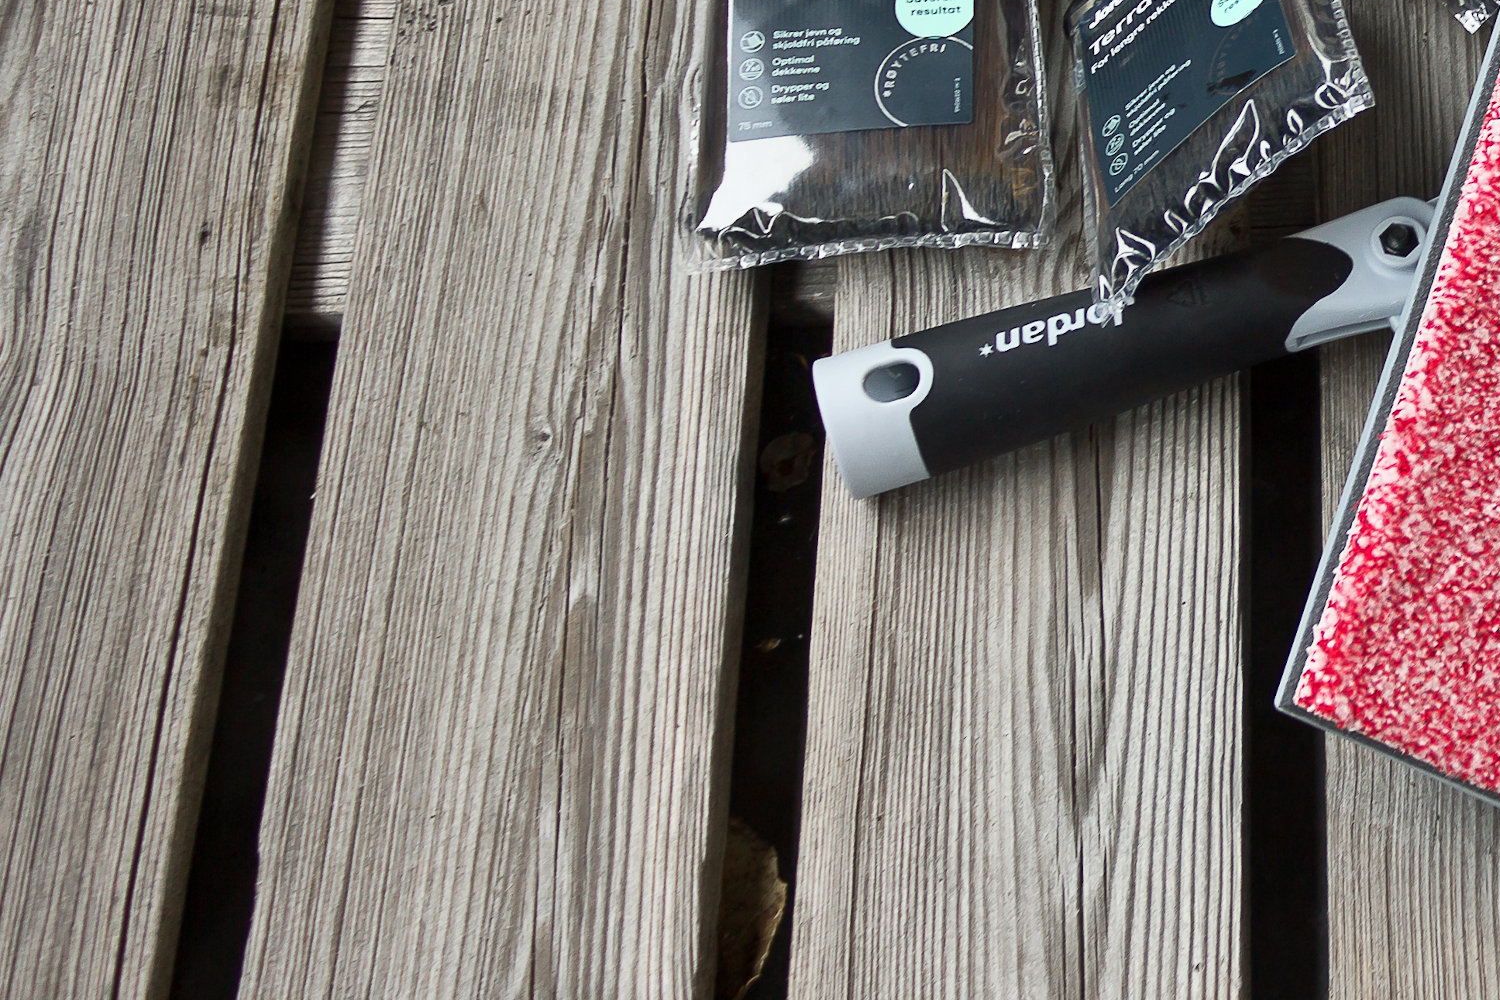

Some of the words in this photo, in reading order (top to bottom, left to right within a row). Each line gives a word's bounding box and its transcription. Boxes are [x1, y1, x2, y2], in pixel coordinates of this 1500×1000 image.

[911, 6, 961, 16] resultat
[828, 28, 842, 36] og
[1091, 54, 1109, 74] For
[1110, 23, 1145, 56] lengre
[772, 55, 815, 66] Optimal
[771, 83, 814, 93] Drypper
[815, 82, 829, 91] og
